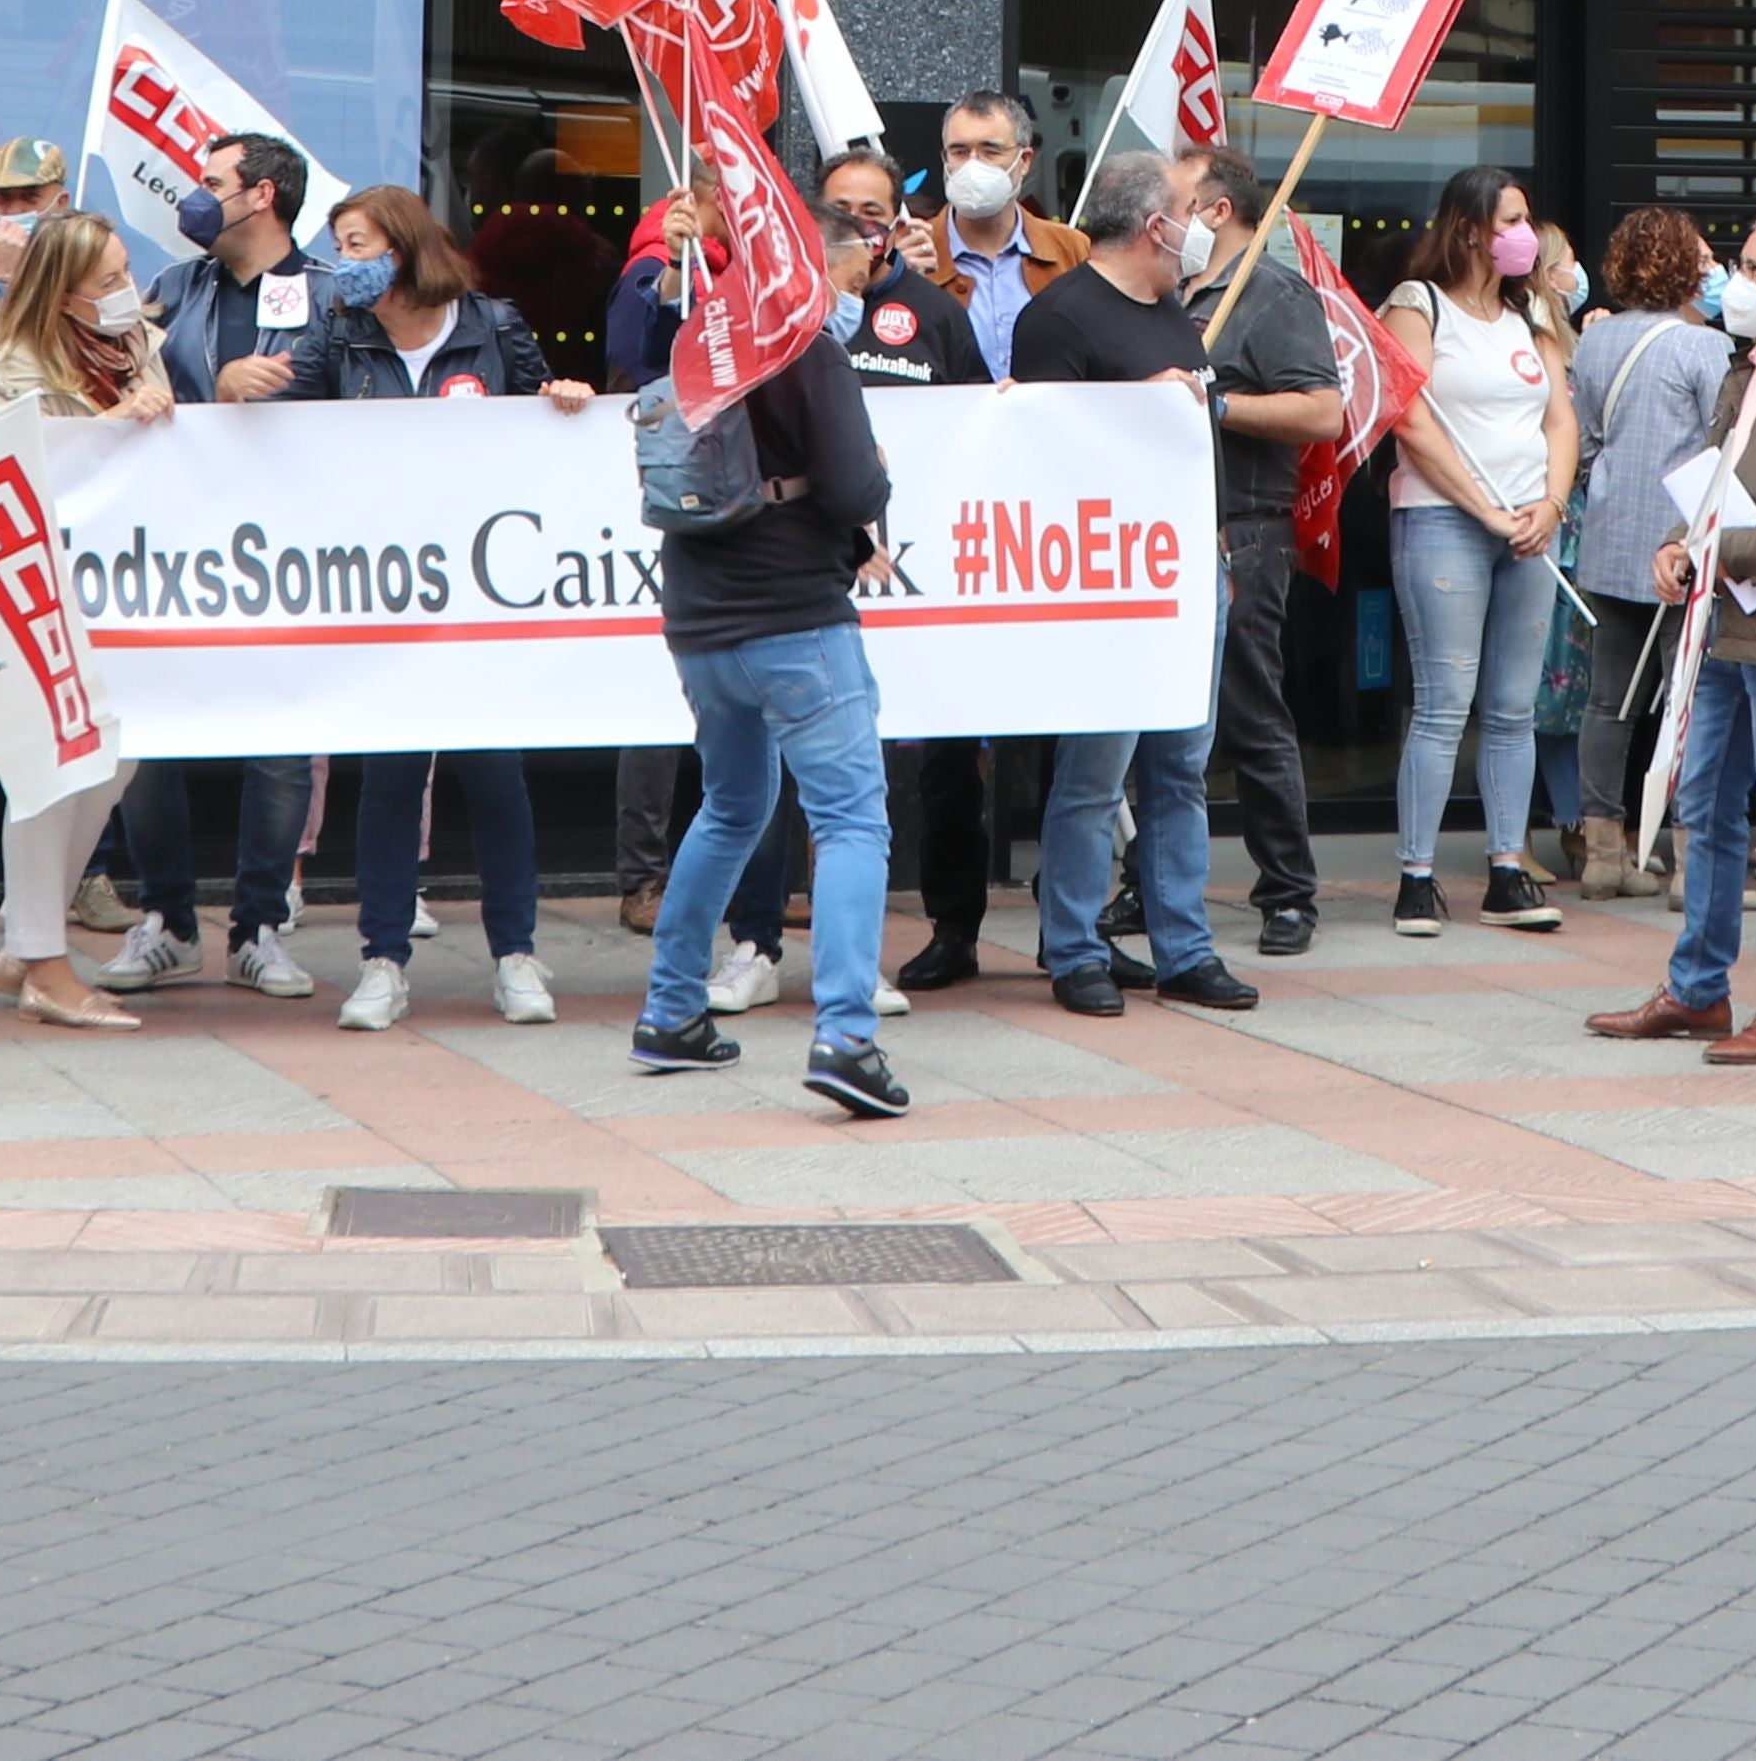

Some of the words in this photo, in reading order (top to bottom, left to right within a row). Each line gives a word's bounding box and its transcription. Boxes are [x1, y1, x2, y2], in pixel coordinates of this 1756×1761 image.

[132, 161, 184, 211] Leó
[850, 351, 932, 382] sCaixaBank
[60, 523, 449, 620] odxsSomos
[952, 498, 1180, 596] #NoEre
